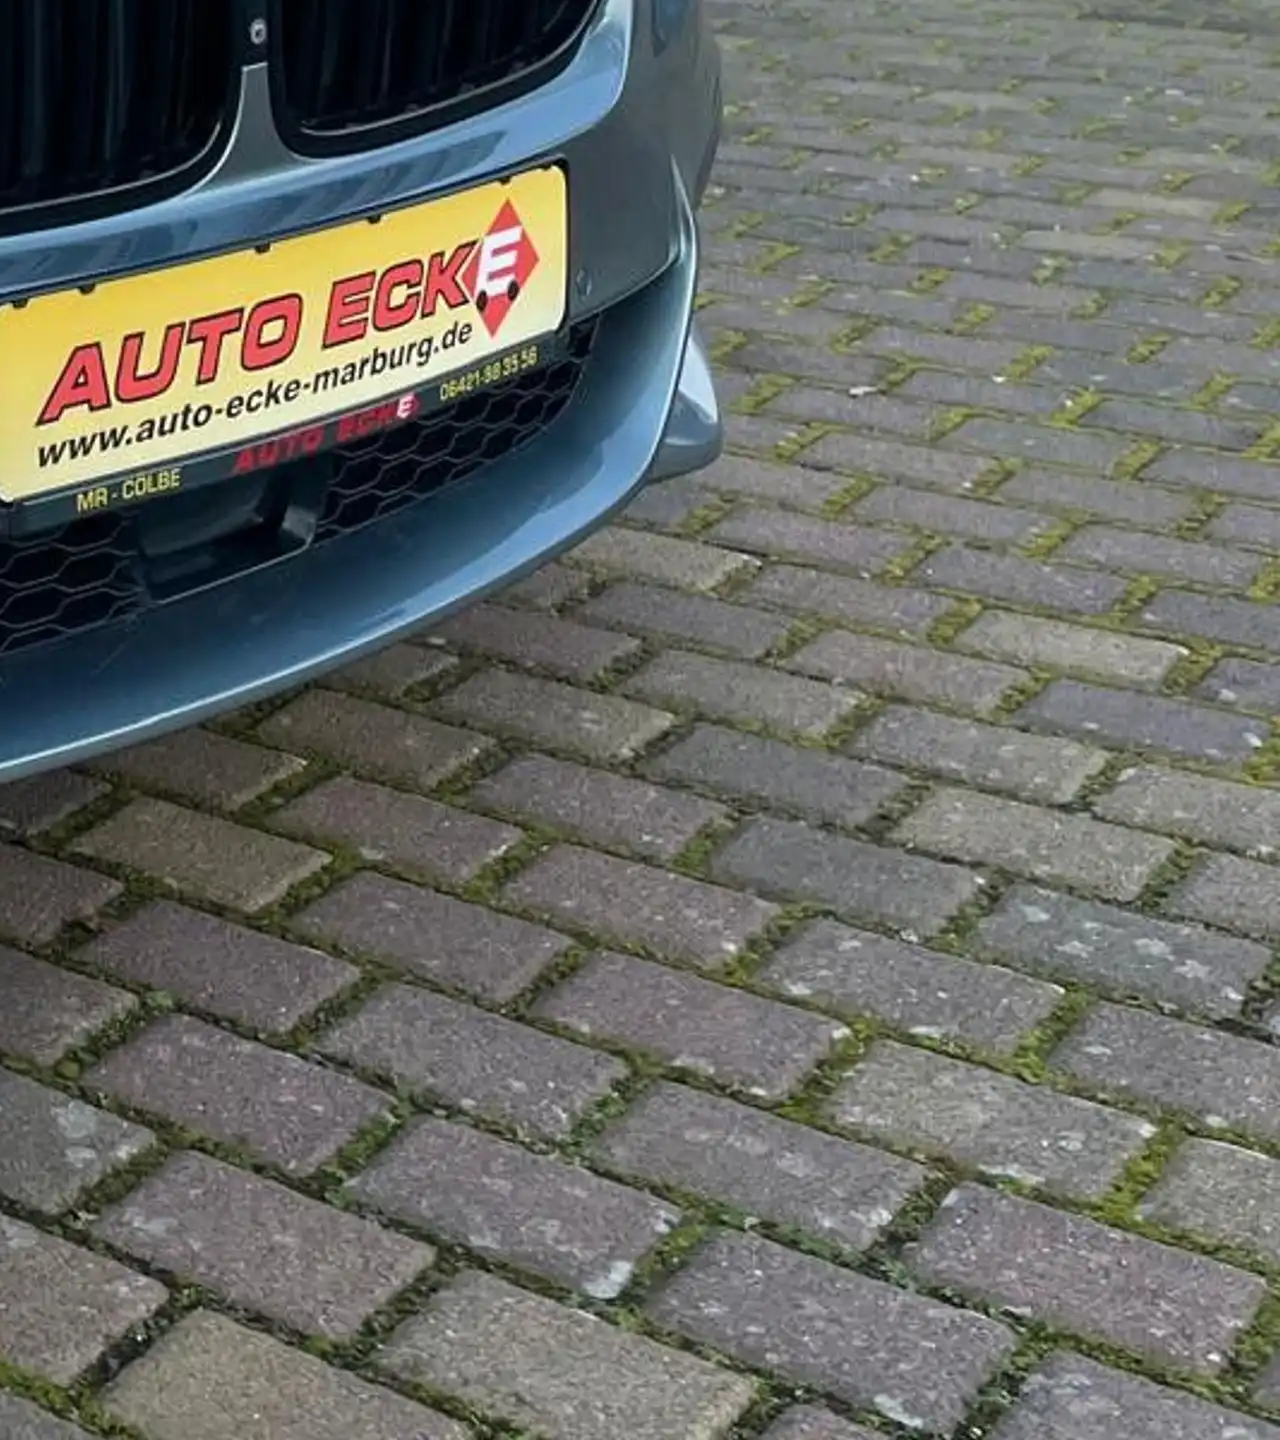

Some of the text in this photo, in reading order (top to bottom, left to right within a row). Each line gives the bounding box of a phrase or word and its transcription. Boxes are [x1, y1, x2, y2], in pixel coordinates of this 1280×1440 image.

[35, 292, 303, 427] AUTO
[37, 319, 474, 468] www.auto-ecke-marburg.de
[230, 426, 324, 475] AUTO
[76, 486, 109, 513] MR
